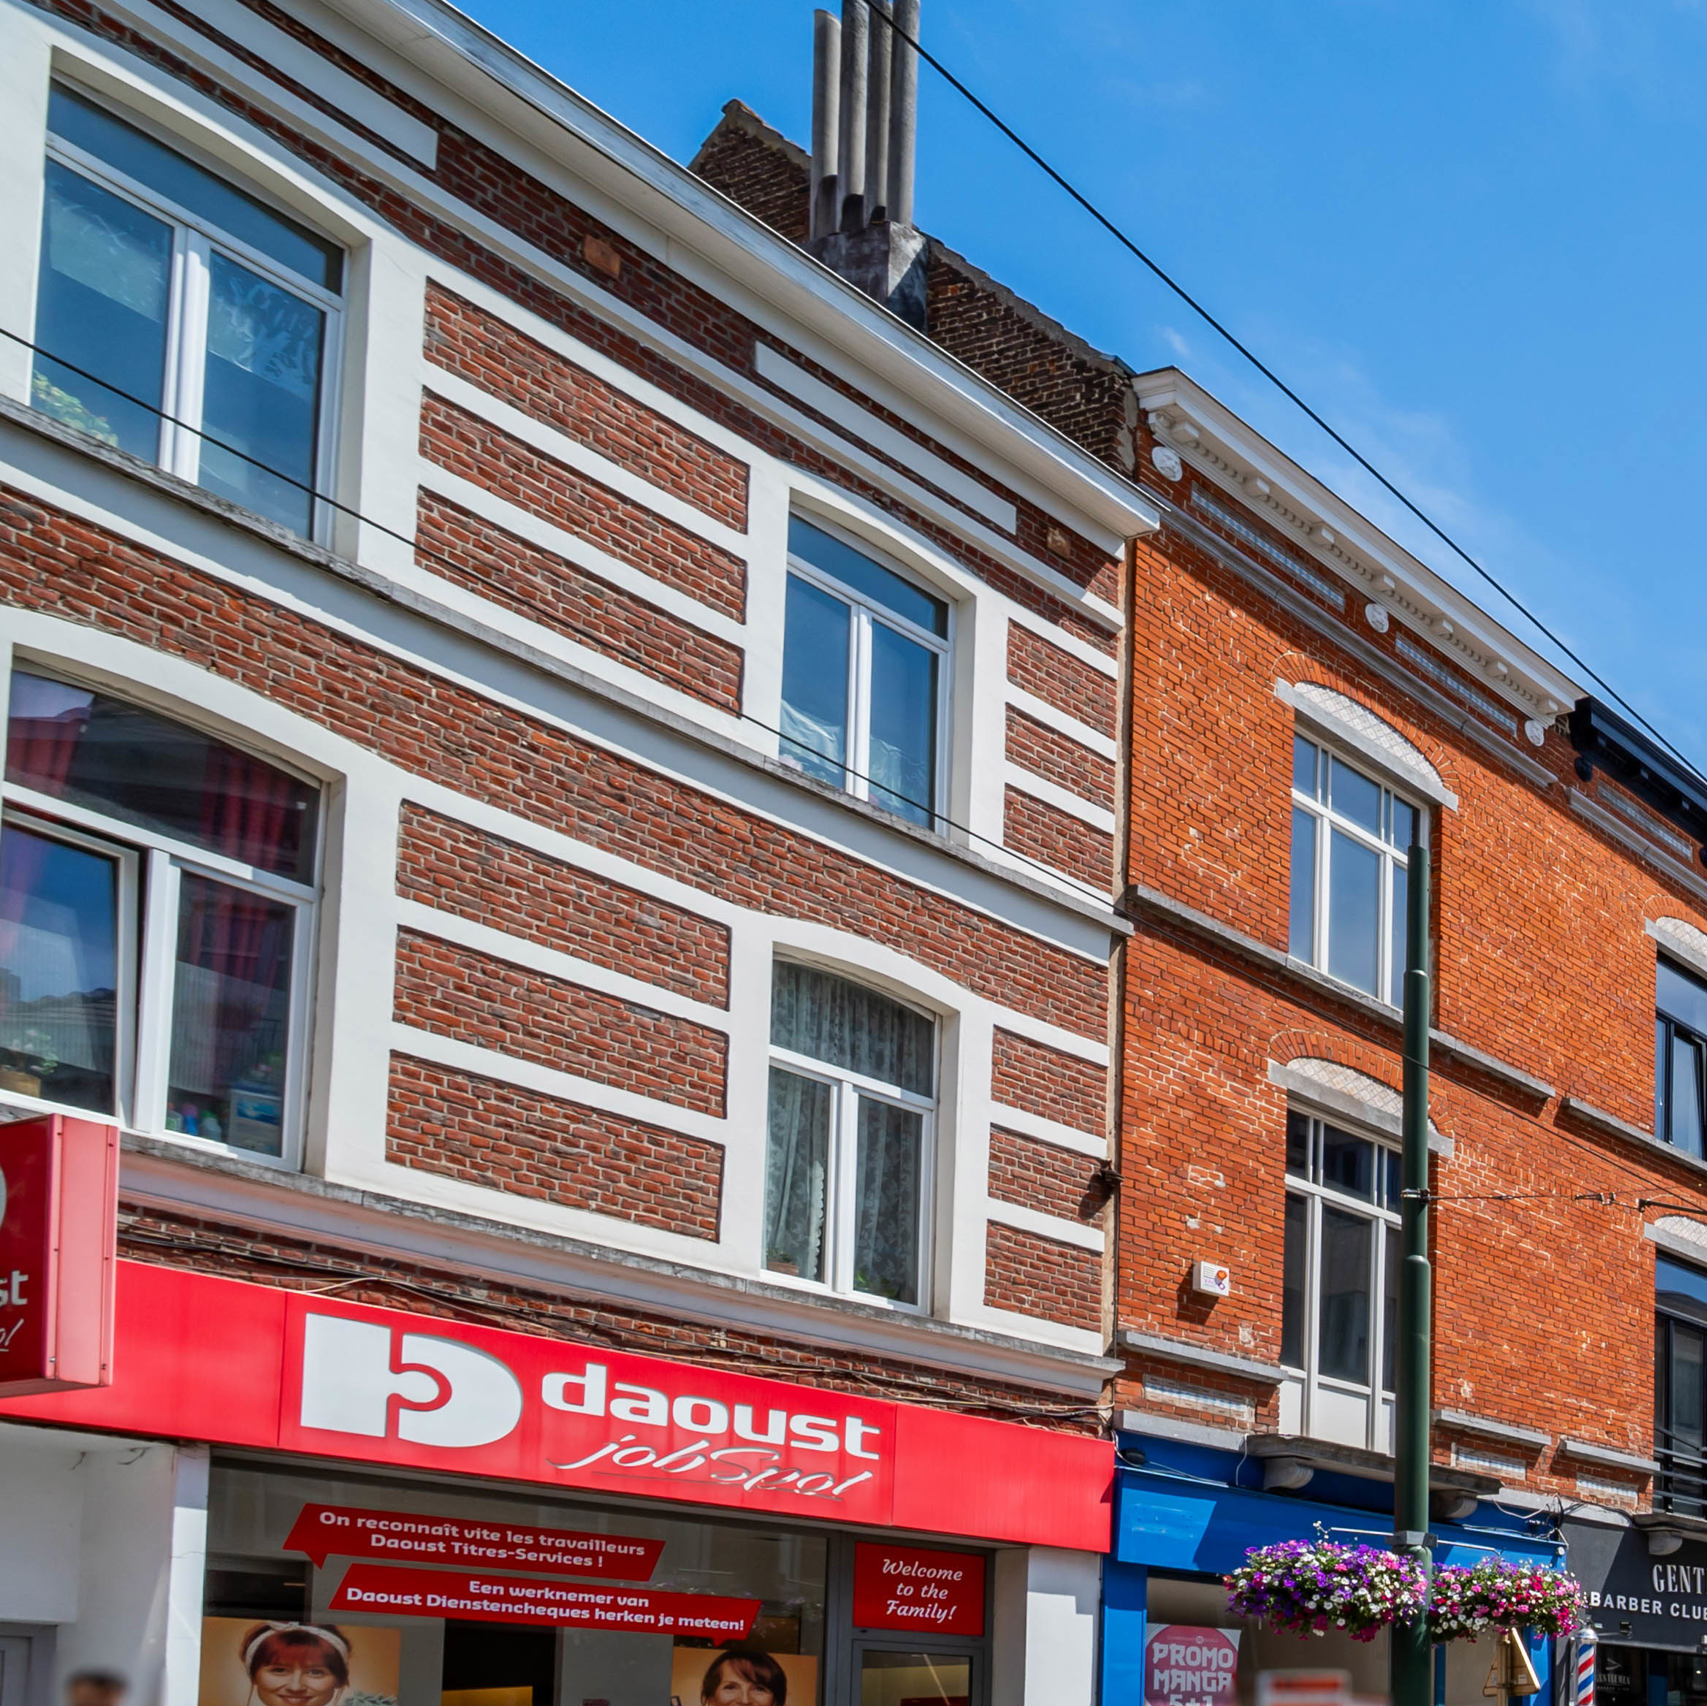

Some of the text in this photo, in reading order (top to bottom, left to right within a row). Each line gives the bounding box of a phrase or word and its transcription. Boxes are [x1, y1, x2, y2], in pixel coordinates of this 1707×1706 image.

[542, 1362, 880, 1460] daoust
[319, 1511, 645, 1556] On reconnaît vite les travailleurs
[371, 1534, 603, 1567] Daoust Titres-Services !
[882, 1559, 963, 1581] Welcome
[469, 1581, 649, 1608] Een werknemer van
[896, 1582, 948, 1599] to the
[1590, 1591, 1662, 1615] BARBER
[346, 1588, 744, 1631] Daoust Dienstencheques herken je meteen!
[886, 1600, 957, 1623] Family!
[1152, 1642, 1234, 1671] PROMO
[1153, 1668, 1232, 1694] MANGA
